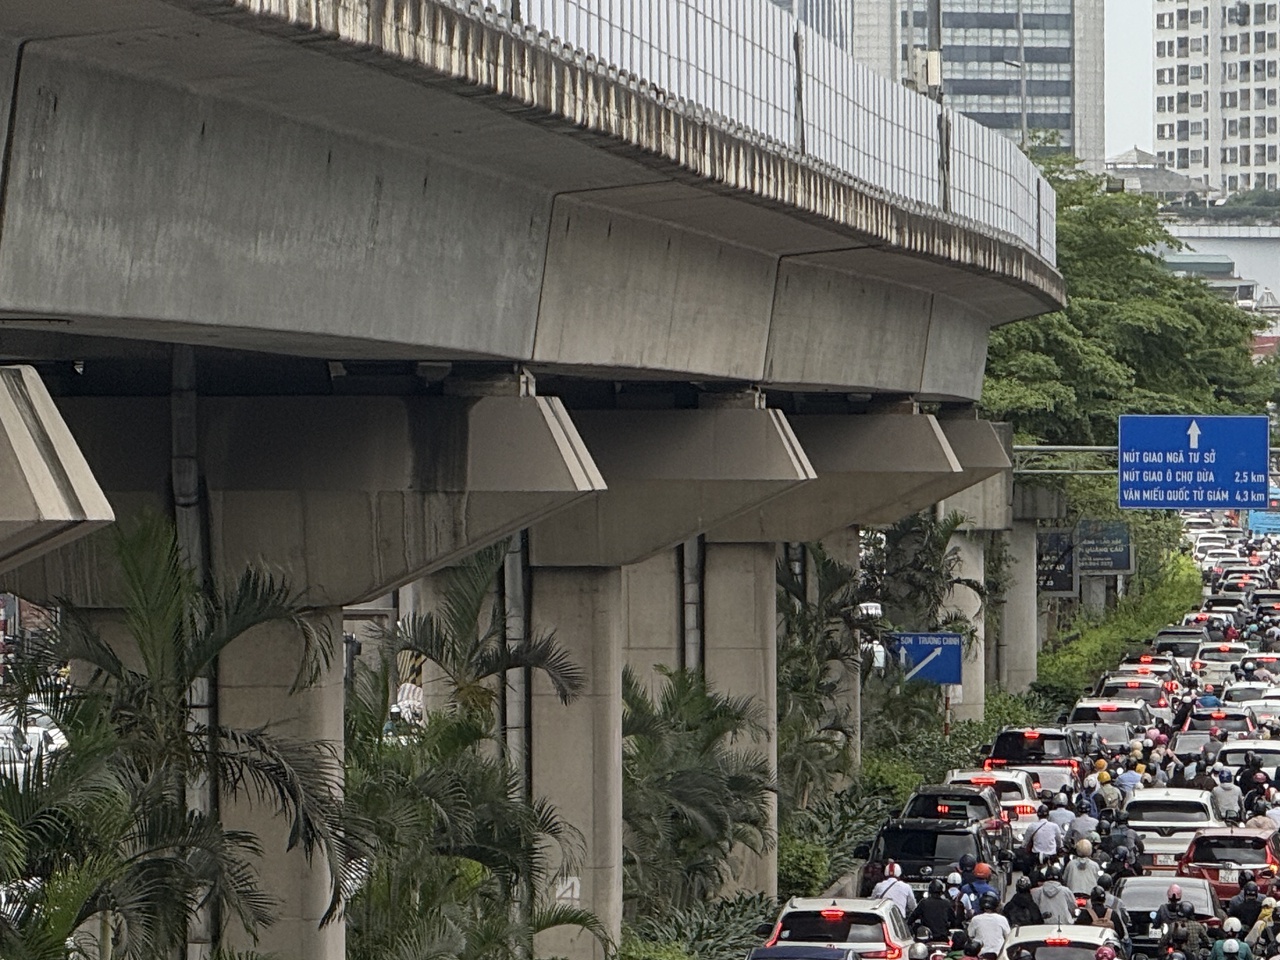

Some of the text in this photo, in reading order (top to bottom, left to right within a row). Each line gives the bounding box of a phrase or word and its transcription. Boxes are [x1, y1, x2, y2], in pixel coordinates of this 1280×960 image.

[1123, 449, 1140, 463] NÚT
[1143, 452, 1163, 463] GIAO
[1167, 450, 1184, 463] NGÃ
[1188, 452, 1200, 463] TƯ
[1123, 469, 1140, 482] NÚT
[1143, 471, 1163, 482] GIAO
[1235, 472, 1248, 483] 2,5
[1251, 471, 1265, 482] km
[1166, 486, 1190, 501] QUỐC
[1207, 487, 1229, 501] GIÁM
[1235, 490, 1248, 502] 4,3
[1251, 490, 1265, 501] km
